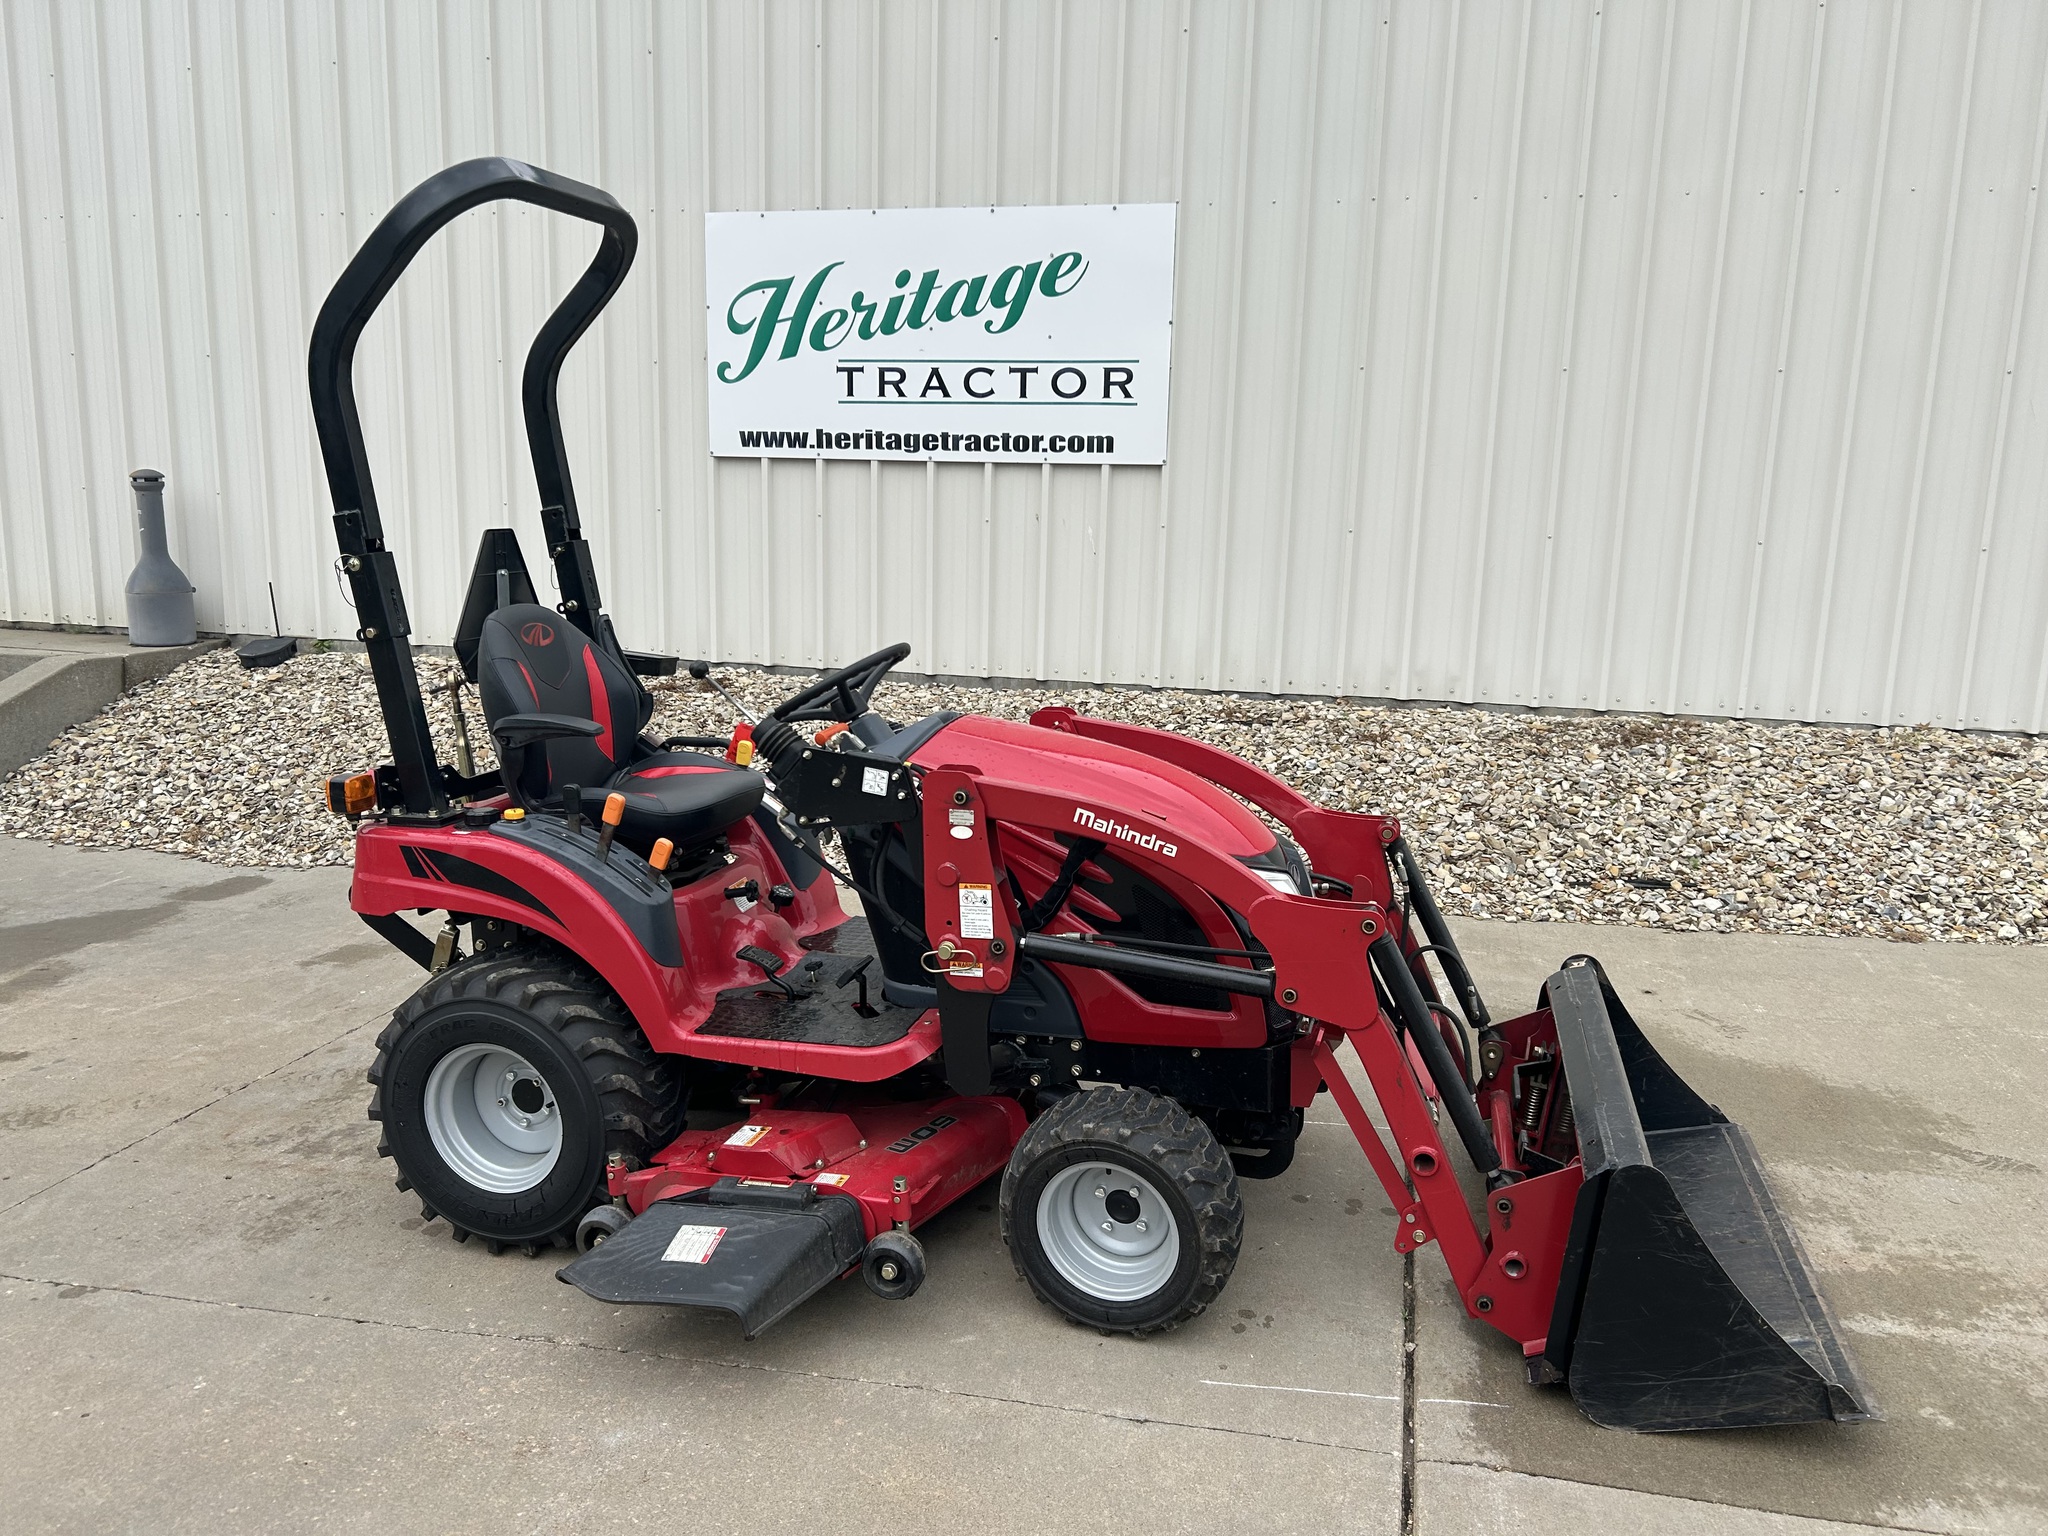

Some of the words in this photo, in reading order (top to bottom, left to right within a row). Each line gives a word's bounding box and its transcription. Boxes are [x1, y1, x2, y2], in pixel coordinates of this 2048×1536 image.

[717, 252, 1089, 383] Heritage
[836, 365, 1134, 400] TRACTOR
[739, 428, 1115, 454] www.heritagetractor.com
[1073, 807, 1178, 858] Mahindra
